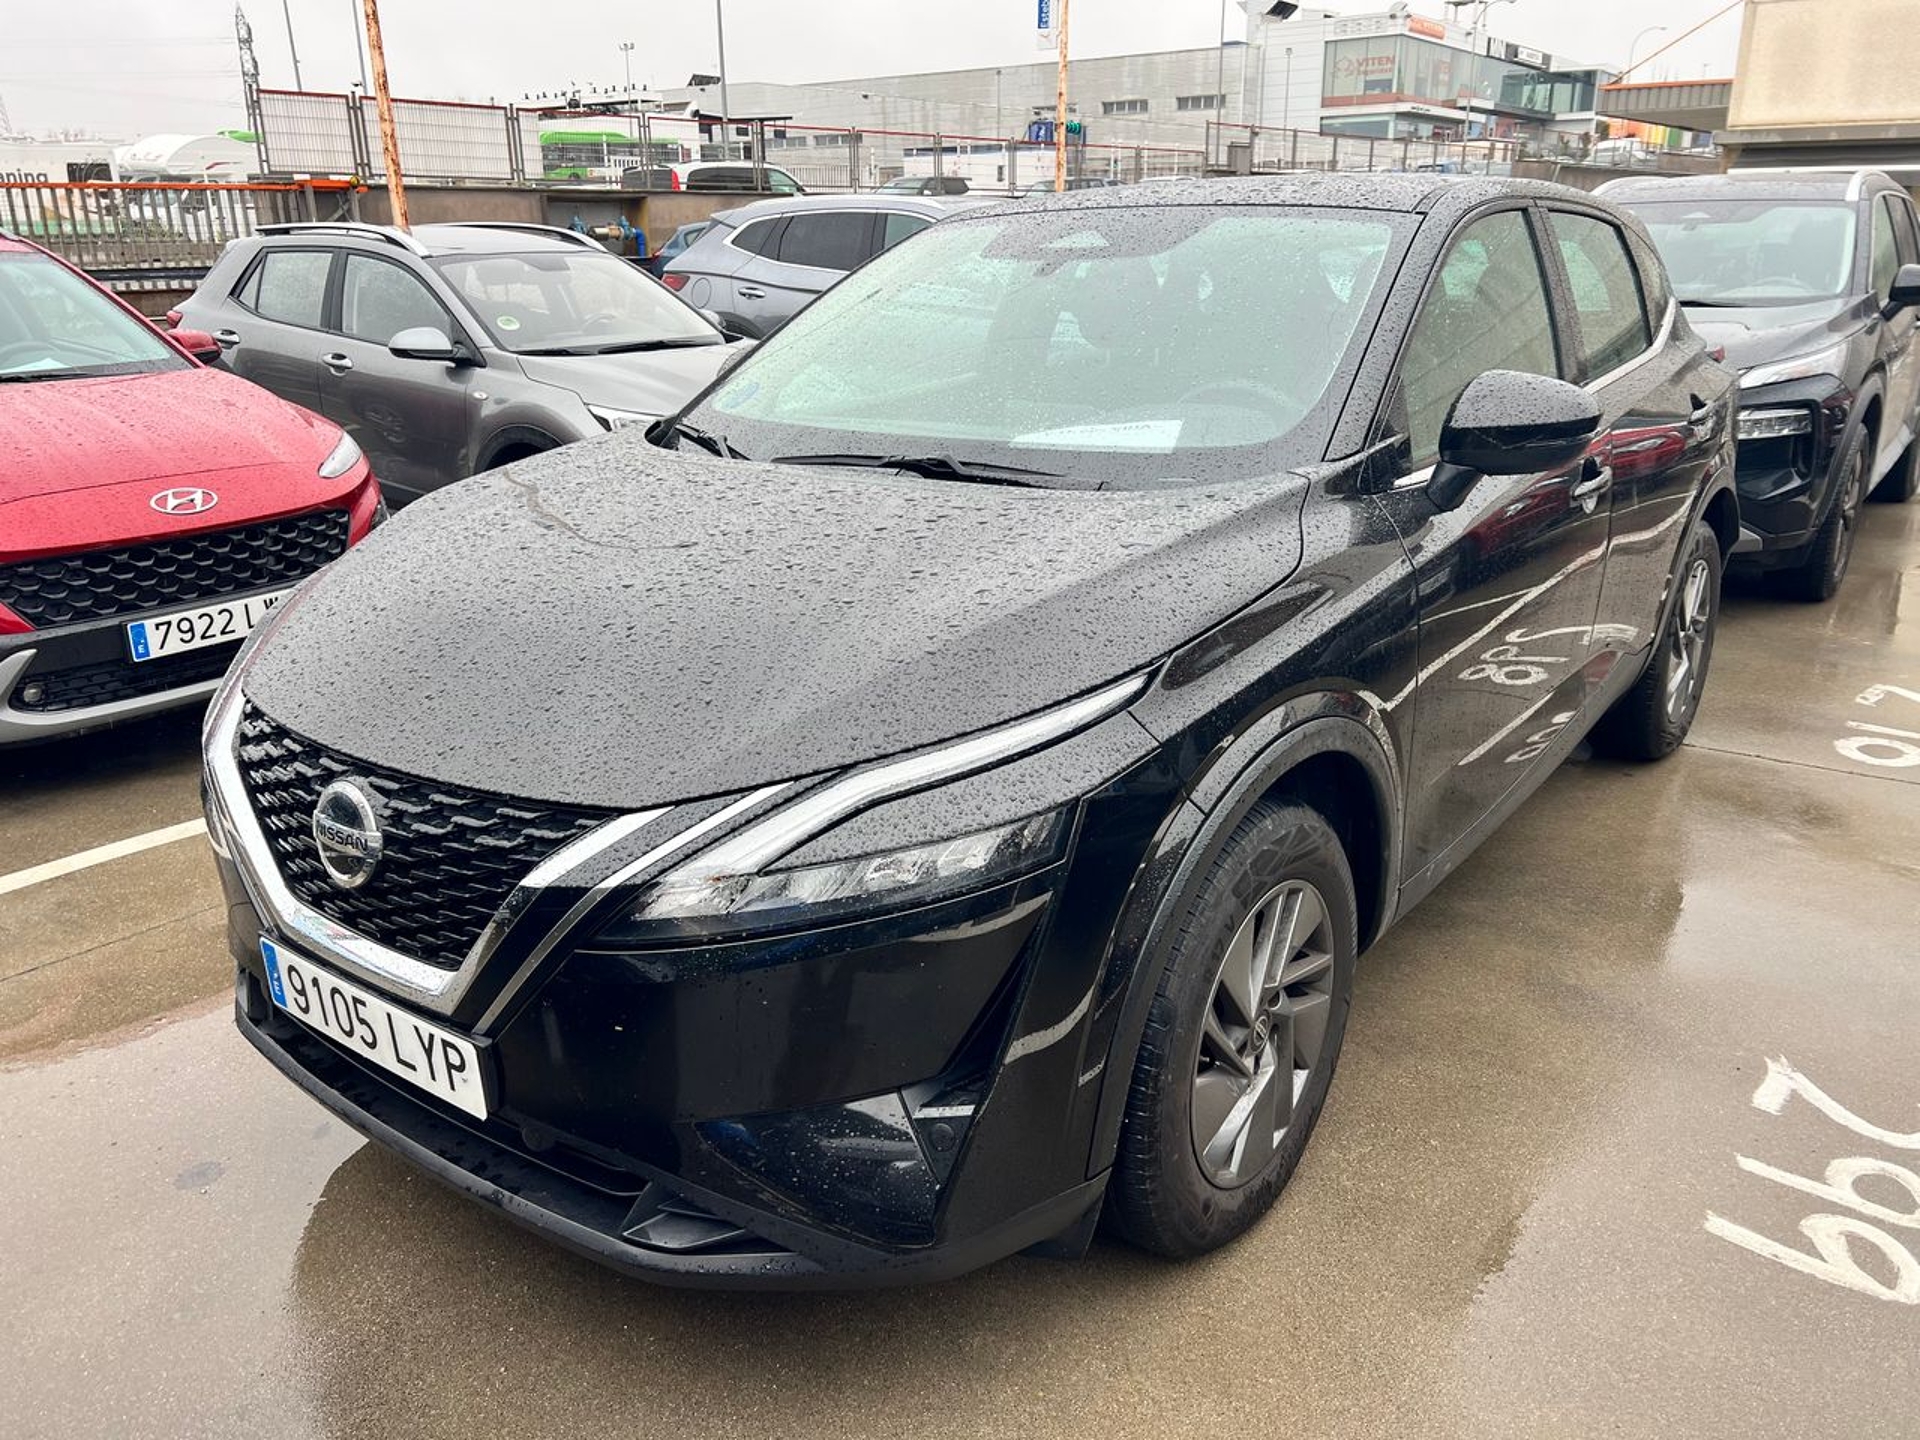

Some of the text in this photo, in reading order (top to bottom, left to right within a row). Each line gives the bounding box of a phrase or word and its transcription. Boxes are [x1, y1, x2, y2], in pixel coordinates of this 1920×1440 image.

[1356, 55, 1396, 68] VITEN
[154, 608, 237, 651] 7922
[318, 822, 369, 852] NISSAN
[287, 964, 467, 1092] 9105 LYP
